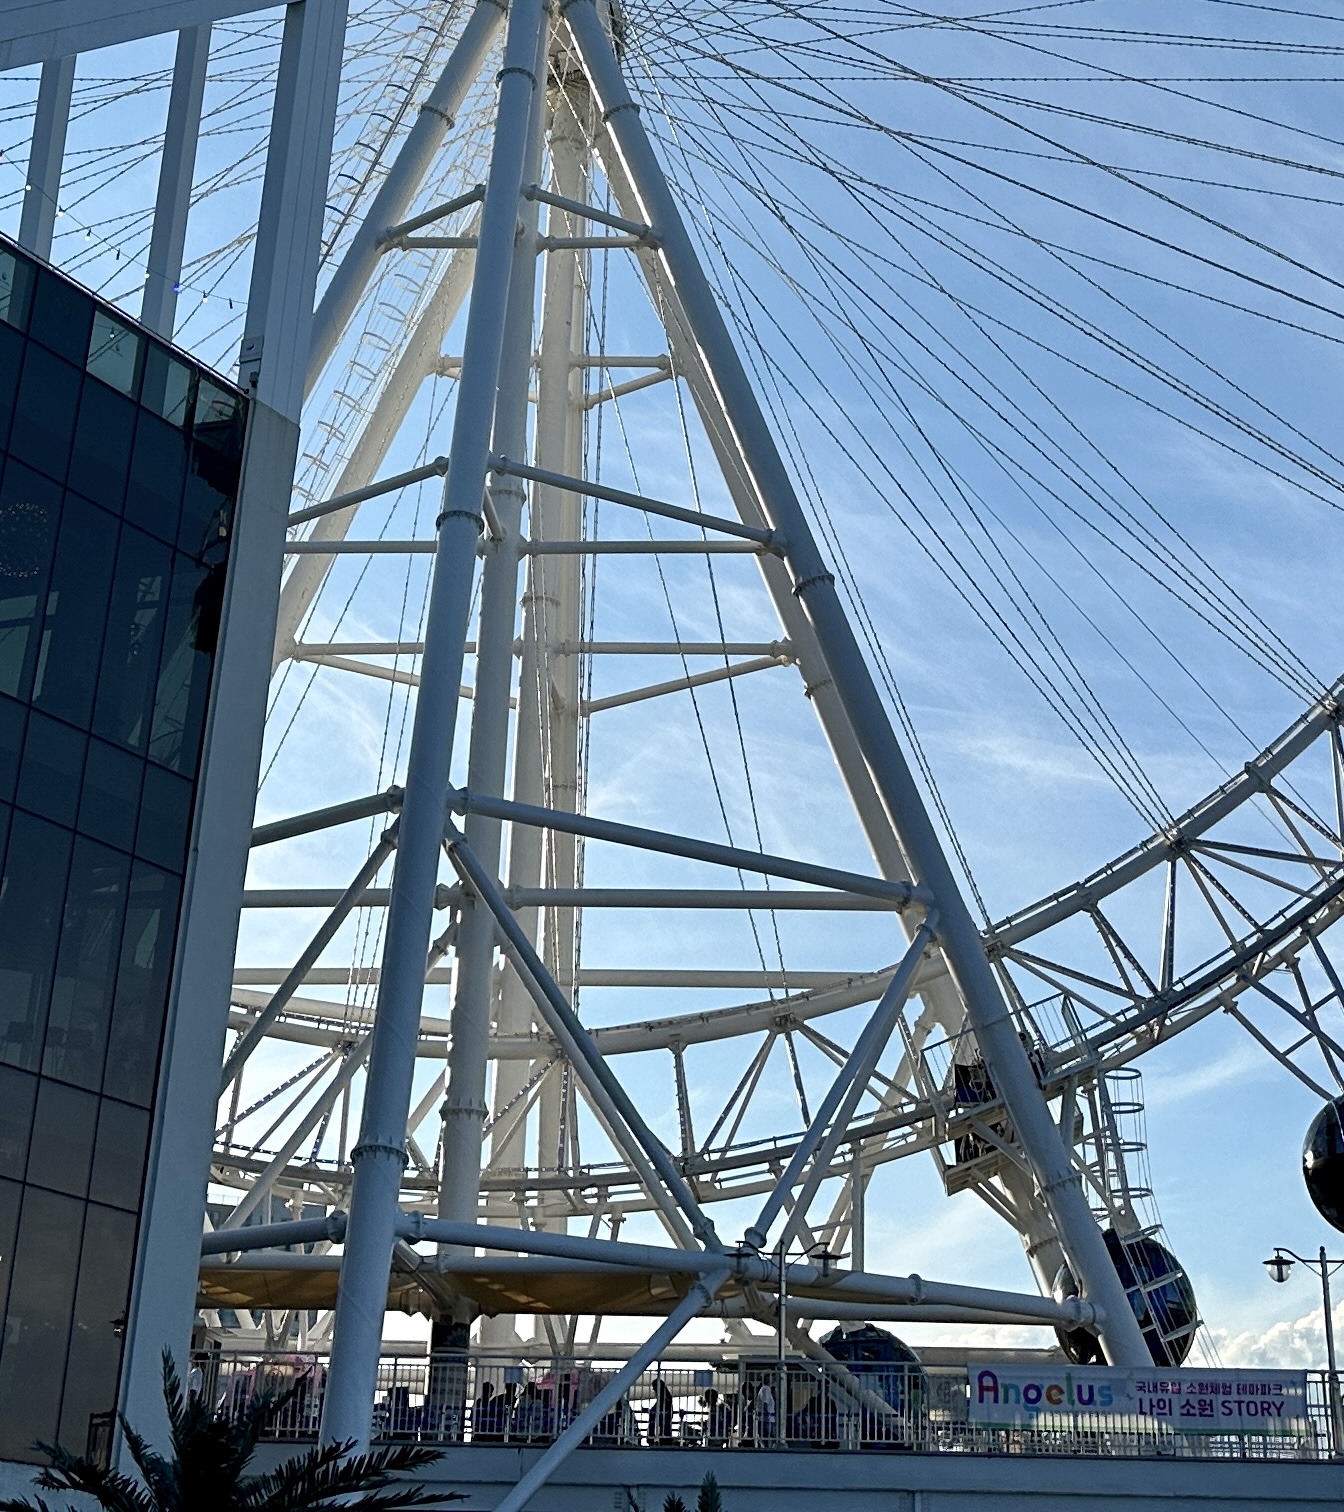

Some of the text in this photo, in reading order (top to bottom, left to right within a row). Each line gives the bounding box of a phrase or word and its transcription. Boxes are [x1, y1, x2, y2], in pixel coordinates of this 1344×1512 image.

[977, 1370, 1113, 1413] Angelus
[1185, 1381, 1232, 1396] 소원체험
[1236, 1382, 1283, 1396] 테마파크
[1138, 1397, 1285, 1417] 나의 소원 STORY
